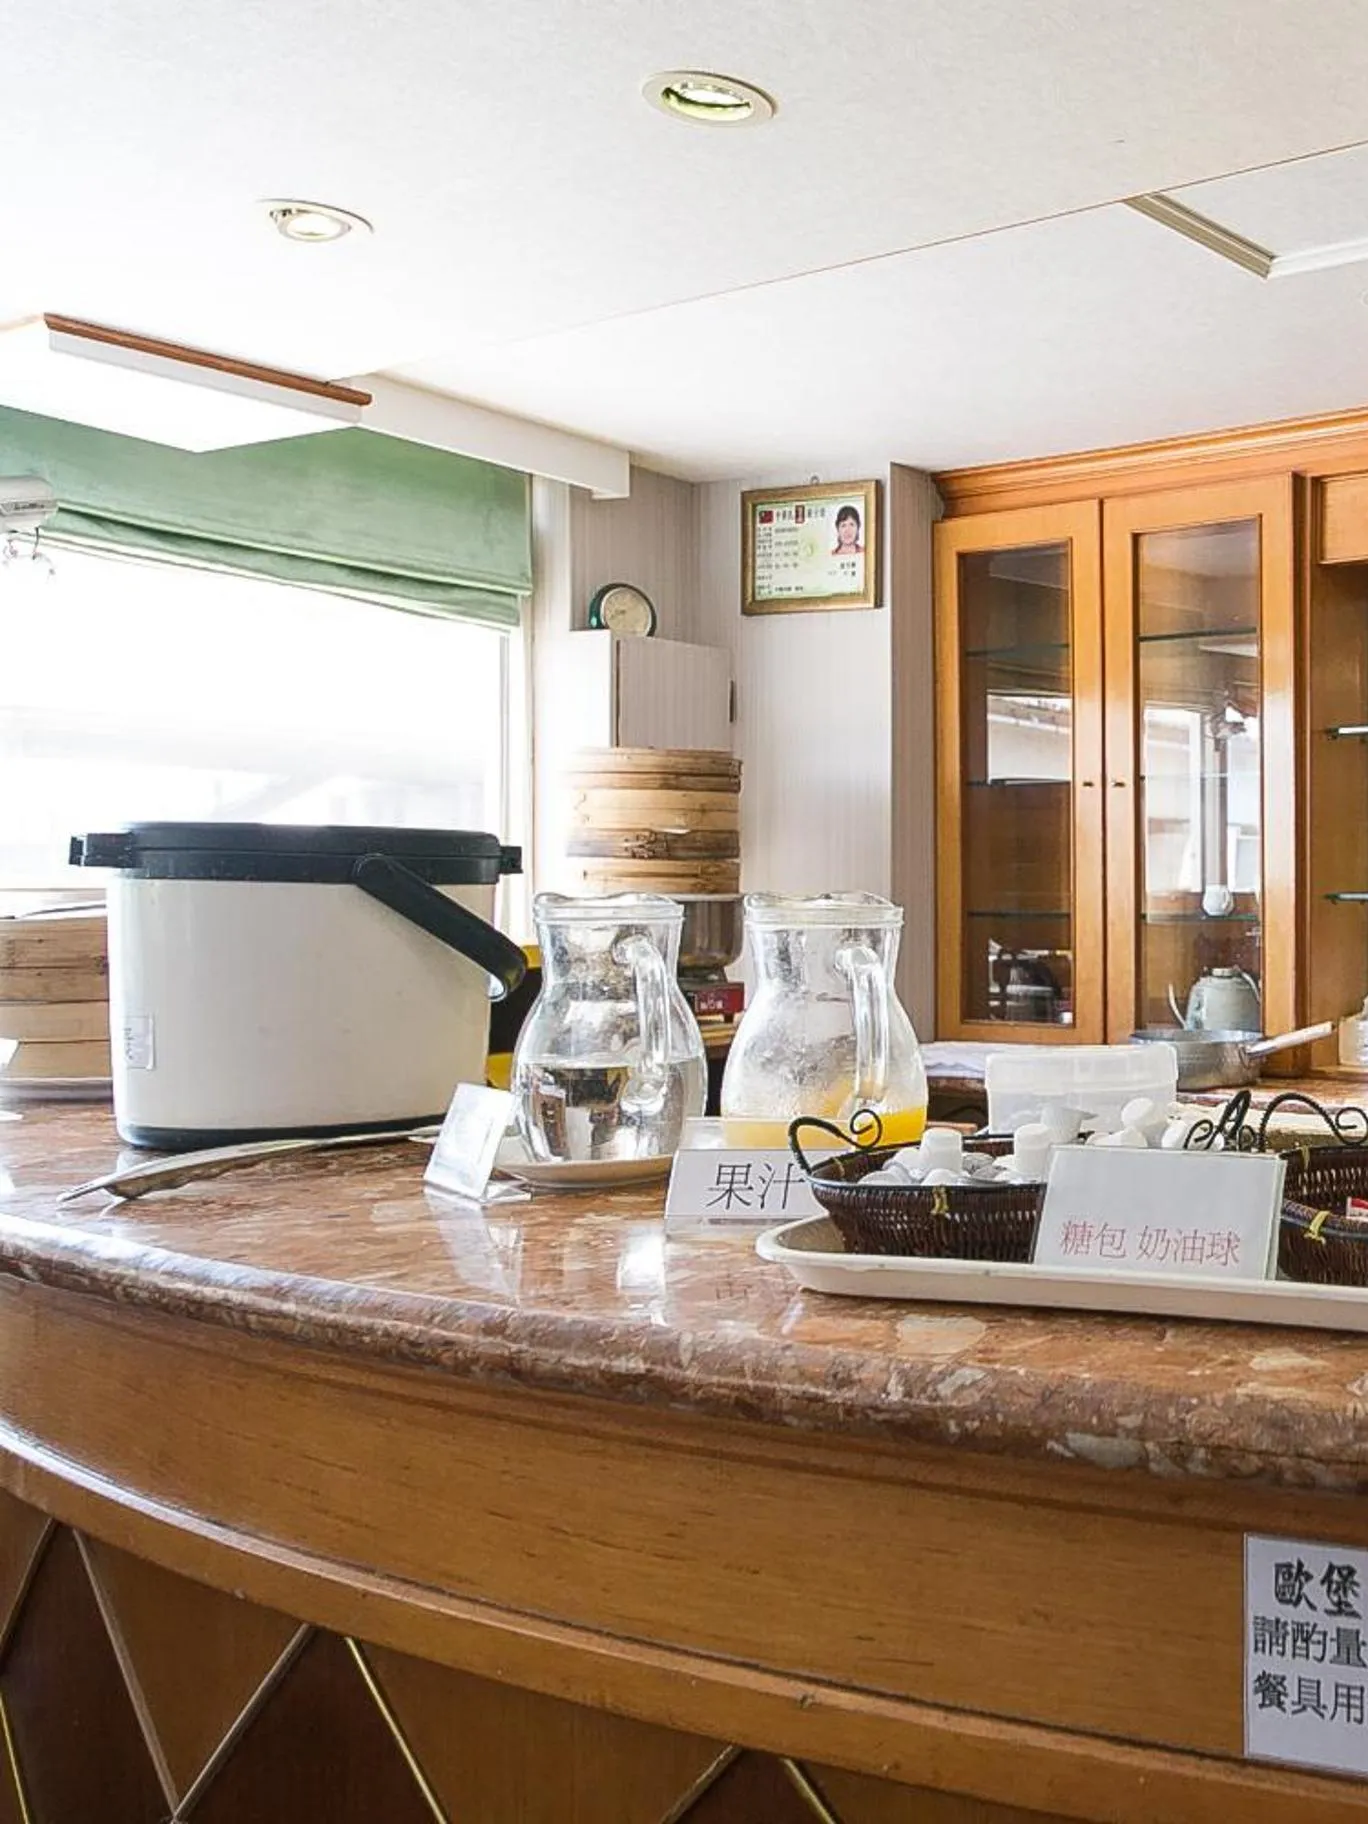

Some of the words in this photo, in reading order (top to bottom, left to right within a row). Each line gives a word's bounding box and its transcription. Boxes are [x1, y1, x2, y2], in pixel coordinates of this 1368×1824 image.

[706, 1163, 806, 1210] 果汁
[1060, 1220, 1126, 1259] 糖包
[1136, 1225, 1241, 1266] 奶油球
